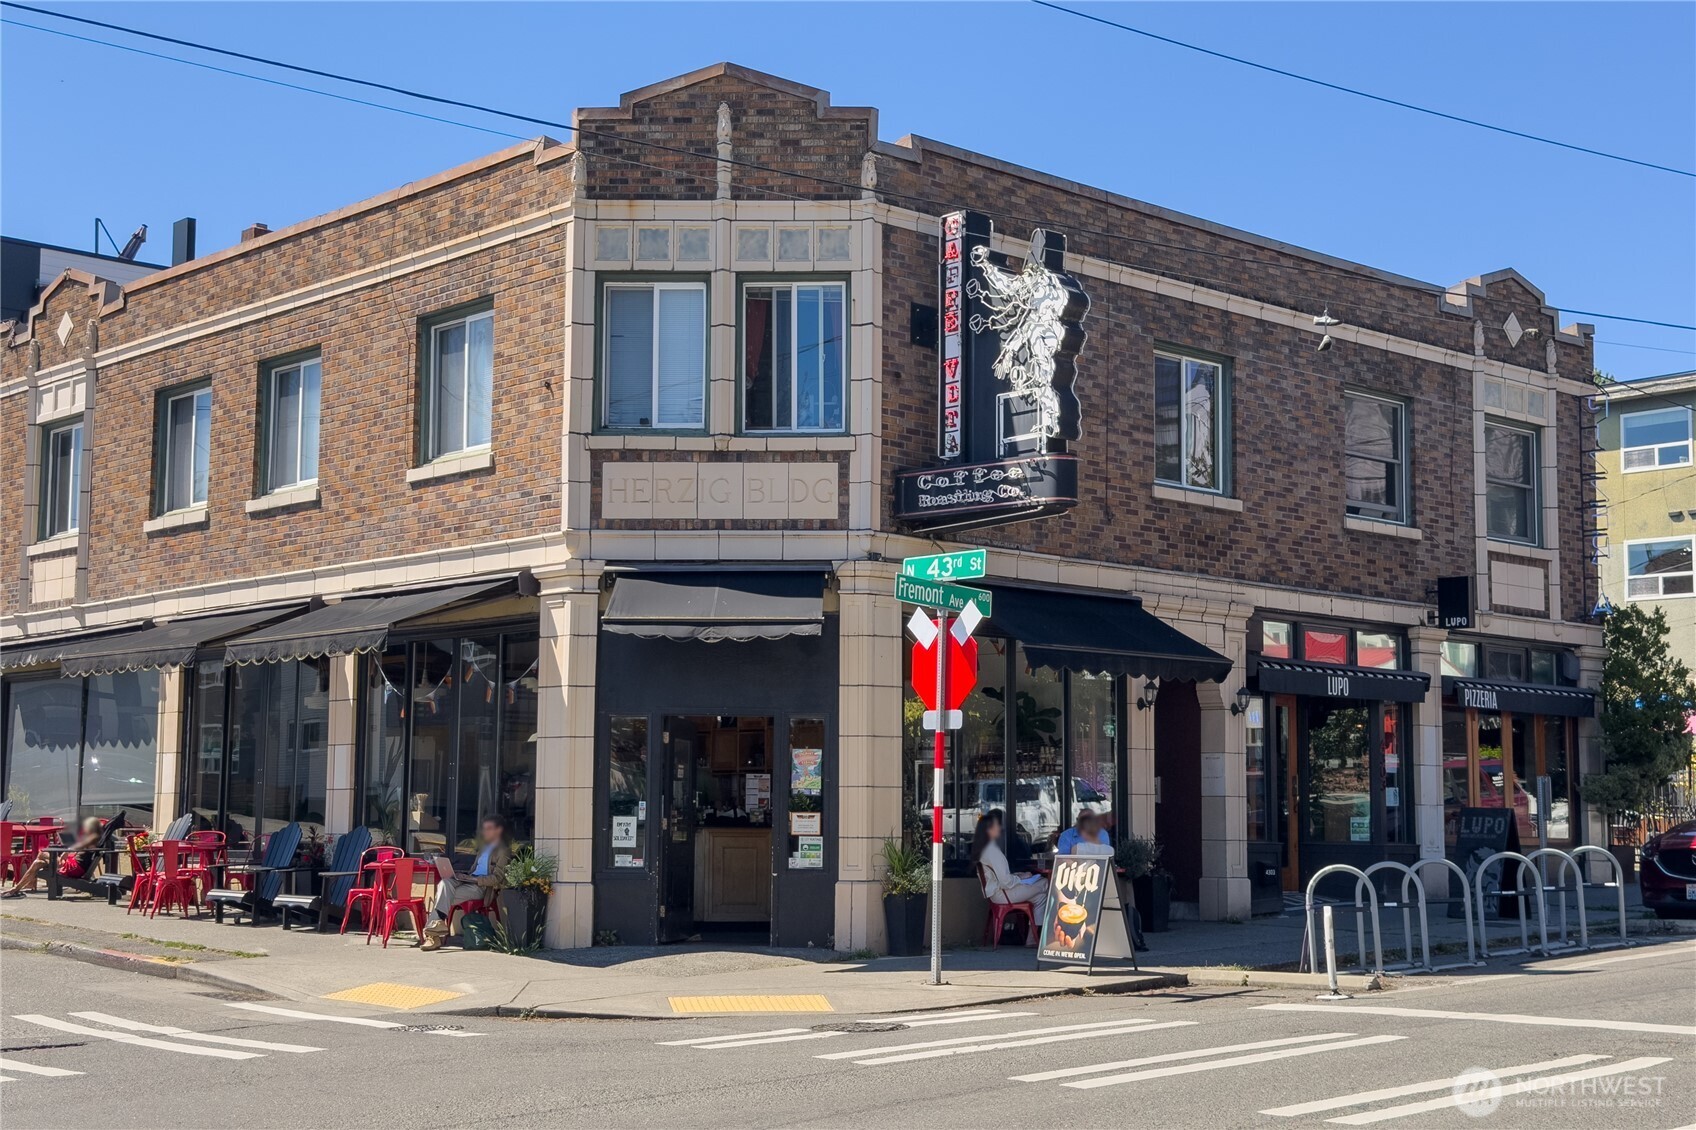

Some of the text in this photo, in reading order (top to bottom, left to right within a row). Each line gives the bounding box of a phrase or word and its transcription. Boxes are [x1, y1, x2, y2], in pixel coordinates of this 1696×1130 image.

[917, 467, 1024, 490] Coffee
[607, 477, 834, 504] HERZIG BLDG
[918, 489, 994, 507] Roasting
[906, 556, 982, 578] N 43rd St
[898, 577, 944, 604] Fremont
[948, 594, 964, 609] Ave
[977, 592, 990, 603] 600
[1445, 616, 1467, 627] LUPO
[1327, 675, 1349, 697] LUPO
[1464, 688, 1498, 710] PIZZERIA
[1460, 816, 1505, 834] LUPO
